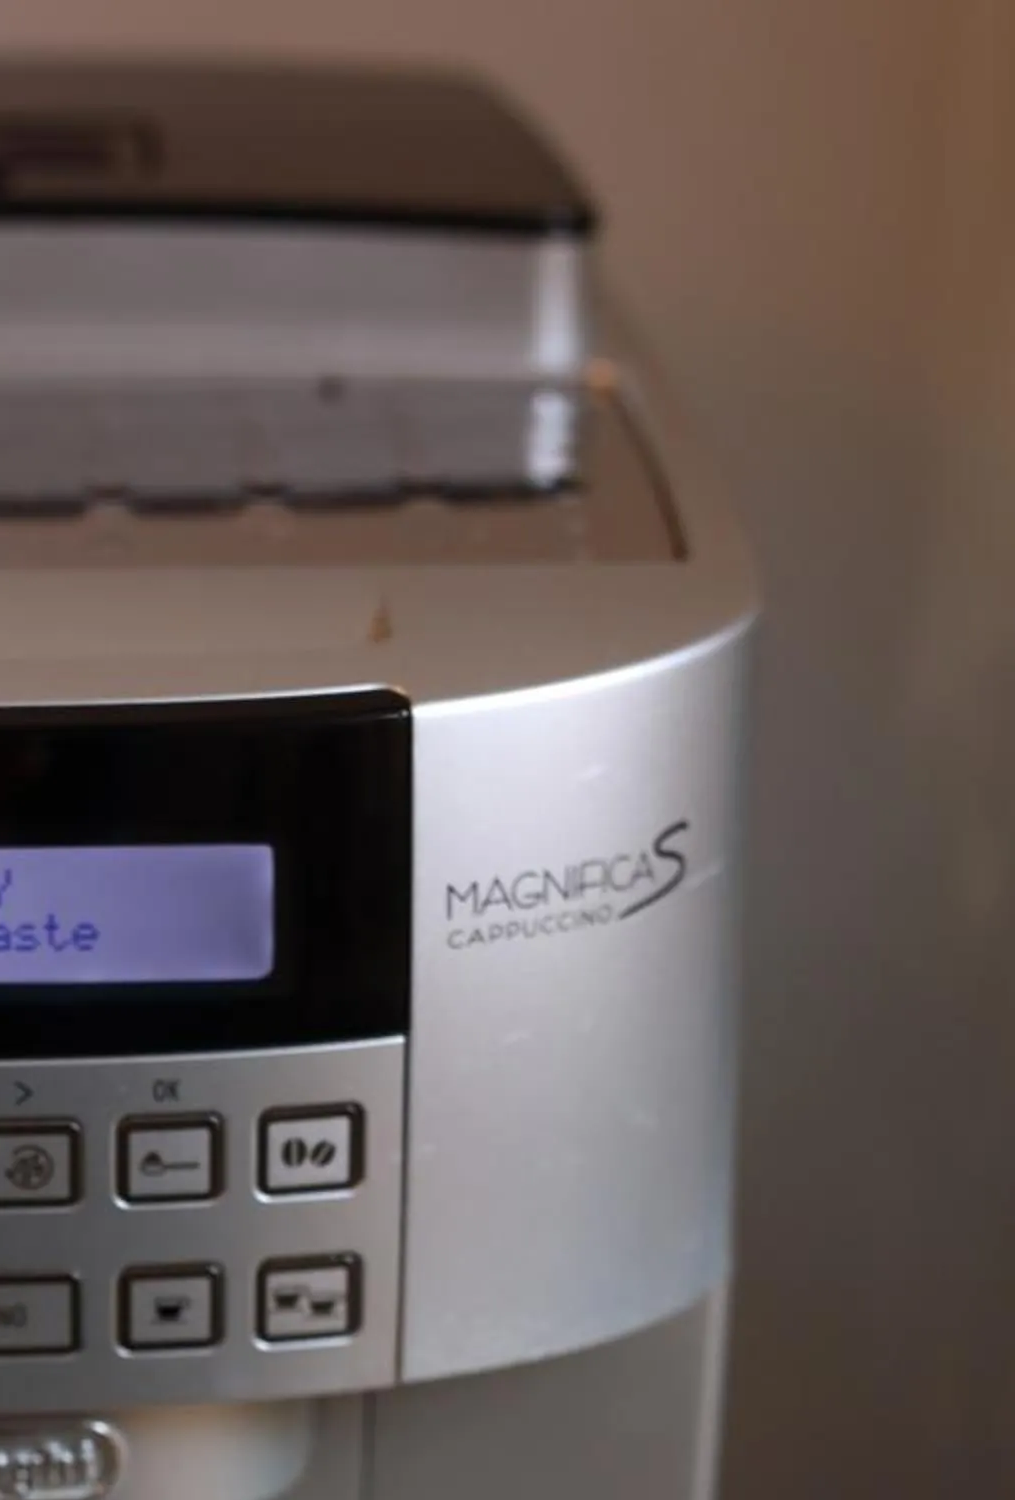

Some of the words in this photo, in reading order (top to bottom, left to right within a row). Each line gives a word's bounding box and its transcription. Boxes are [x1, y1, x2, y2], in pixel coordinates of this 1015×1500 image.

[446, 851, 655, 920] MAGNIFICA
[446, 905, 613, 949] CAPPUCCINO
[153, 1079, 180, 1102] OK
